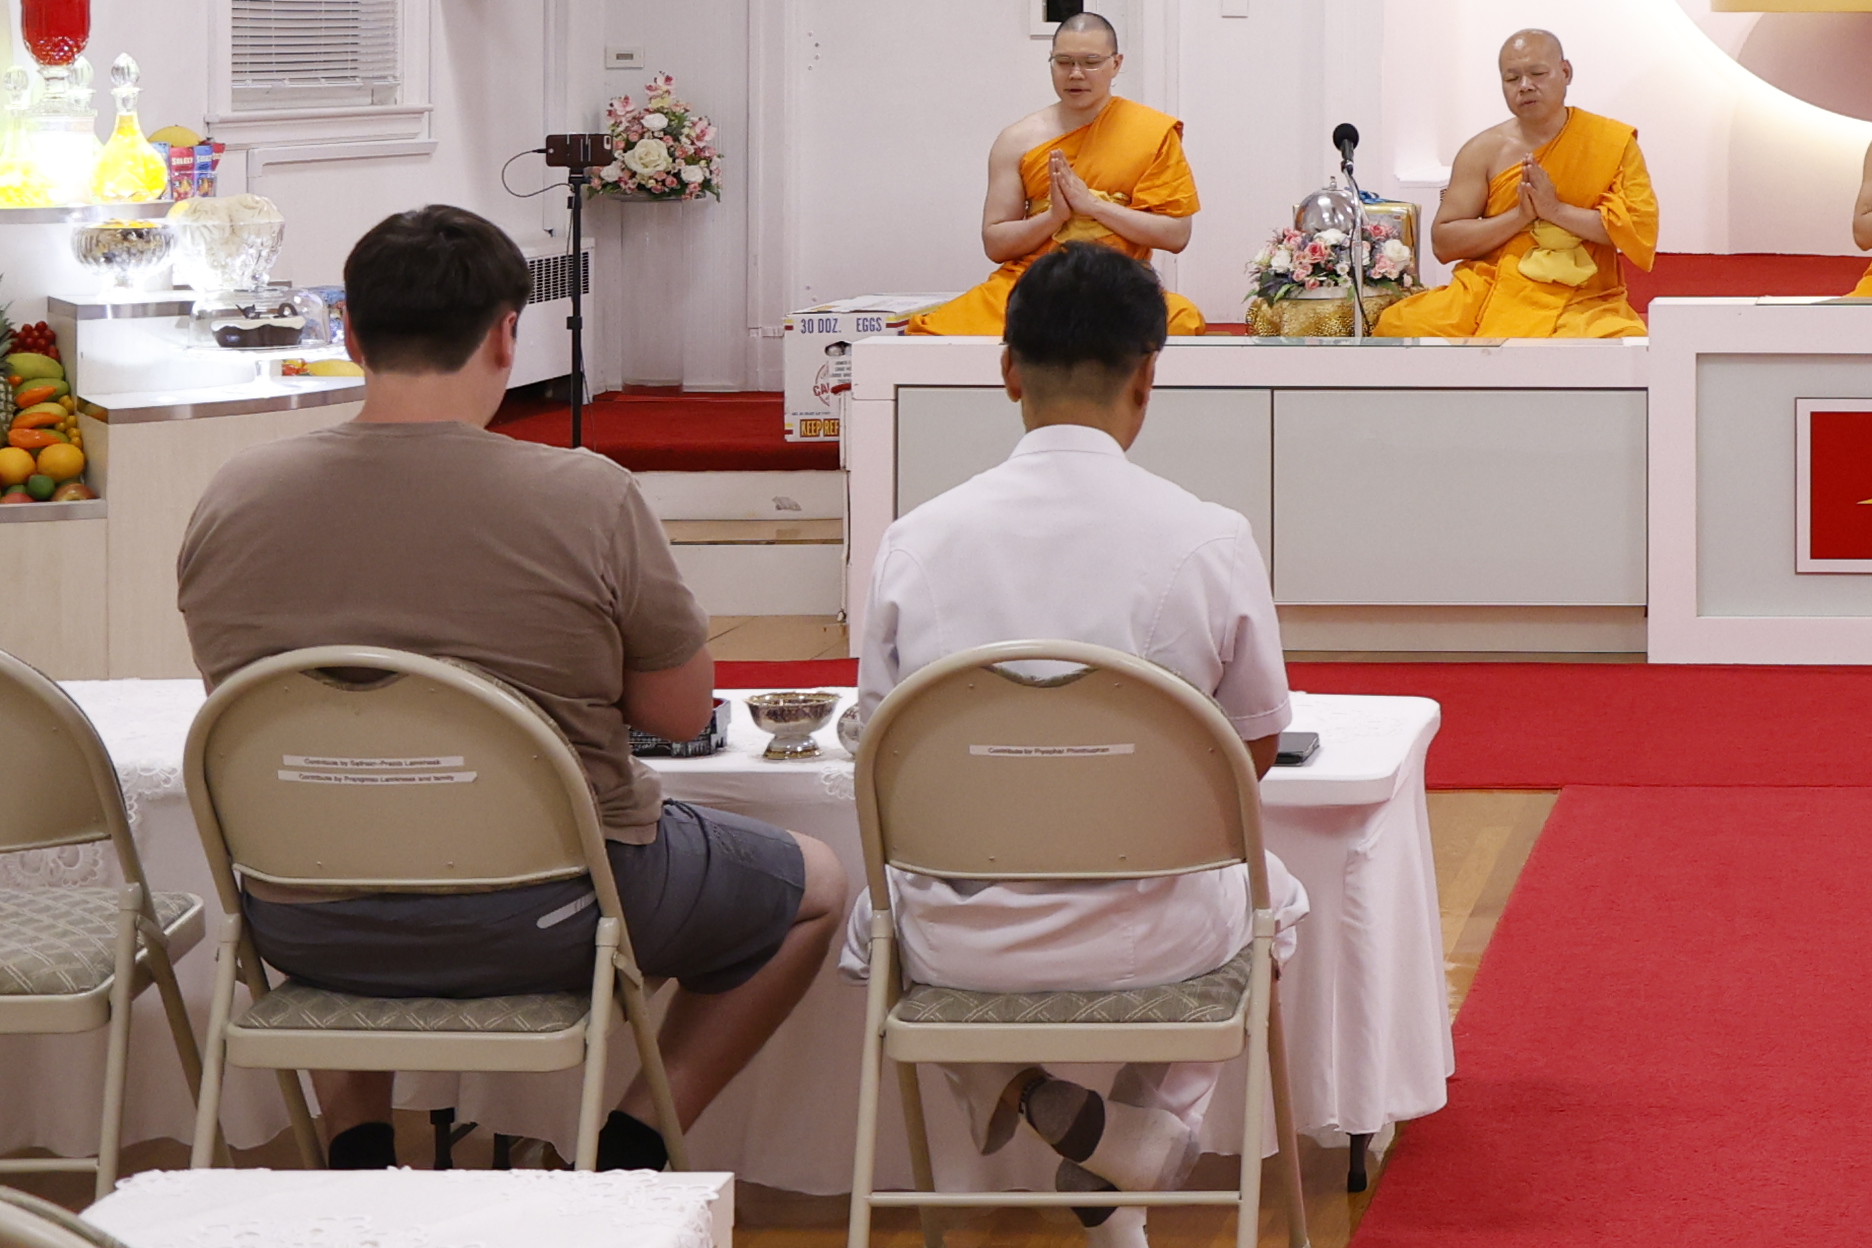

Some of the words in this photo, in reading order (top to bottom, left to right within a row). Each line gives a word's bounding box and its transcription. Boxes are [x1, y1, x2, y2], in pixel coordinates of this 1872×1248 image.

[800, 318, 814, 334] 30
[818, 317, 842, 334] DOZ.
[856, 317, 882, 332] EGGS
[801, 420, 822, 437] KEEP
